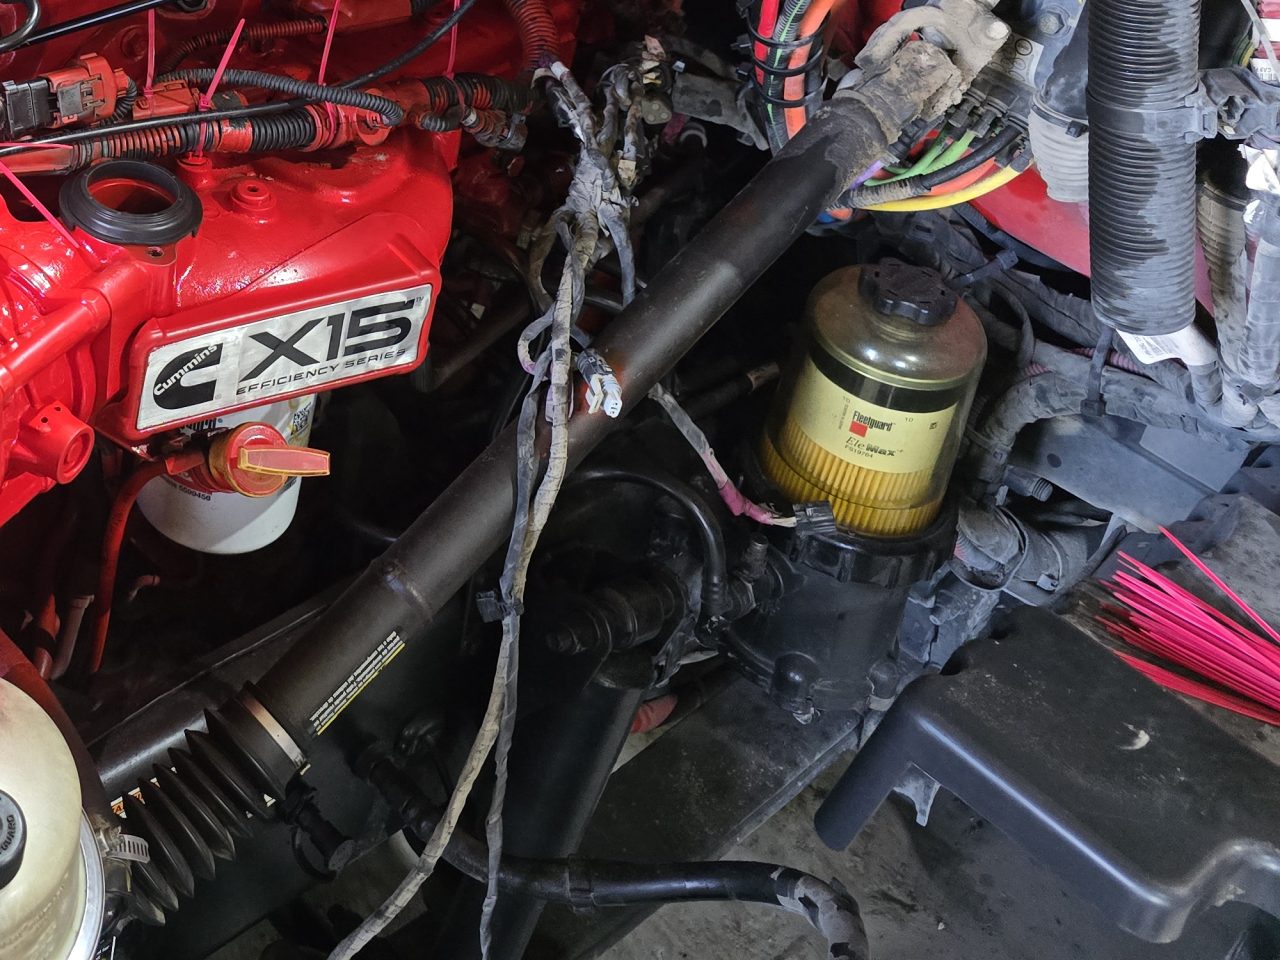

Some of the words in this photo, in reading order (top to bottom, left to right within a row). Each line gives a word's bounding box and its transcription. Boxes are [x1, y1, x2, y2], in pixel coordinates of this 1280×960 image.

[237, 298, 416, 384] X15
[153, 343, 218, 397] Cummins
[236, 363, 339, 396] EFFICIENCY
[345, 348, 407, 369] SERIES
[852, 410, 894, 432] Fleetguard
